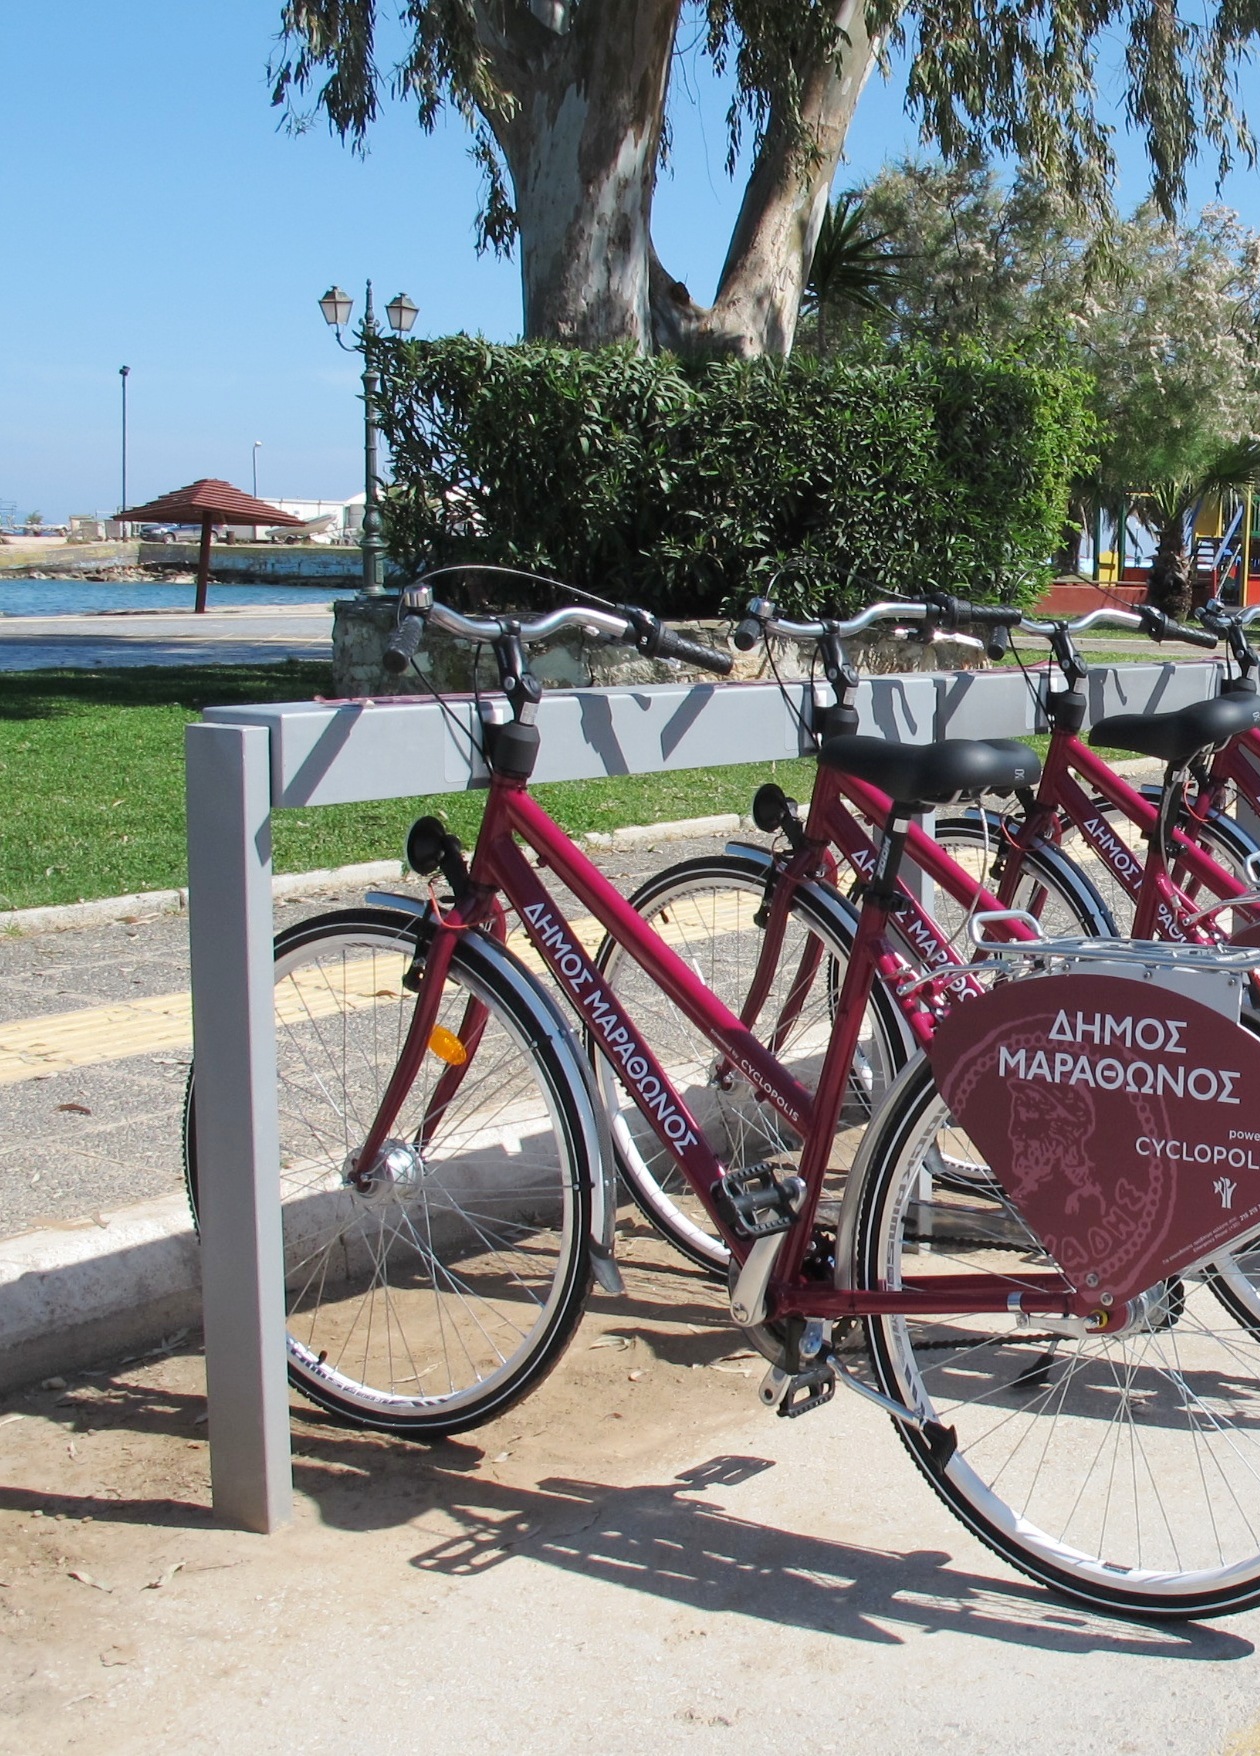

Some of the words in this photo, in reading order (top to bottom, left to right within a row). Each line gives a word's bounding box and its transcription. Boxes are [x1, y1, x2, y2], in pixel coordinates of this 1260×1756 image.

[875, 837, 892, 880] ZOOM
[1083, 818, 1139, 881] ΔΗΜΟΣ
[523, 902, 594, 994] ΔΗΜΟΣ
[583, 990, 698, 1156] ΜΑΡΑΘΩΝΟΣ
[1048, 1009, 1187, 1053] ΔΗΜΟΣ
[741, 1059, 800, 1122] CYCLOPOLIS
[999, 1046, 1241, 1104] ΜΑΡΑΘΩΝΟΣ
